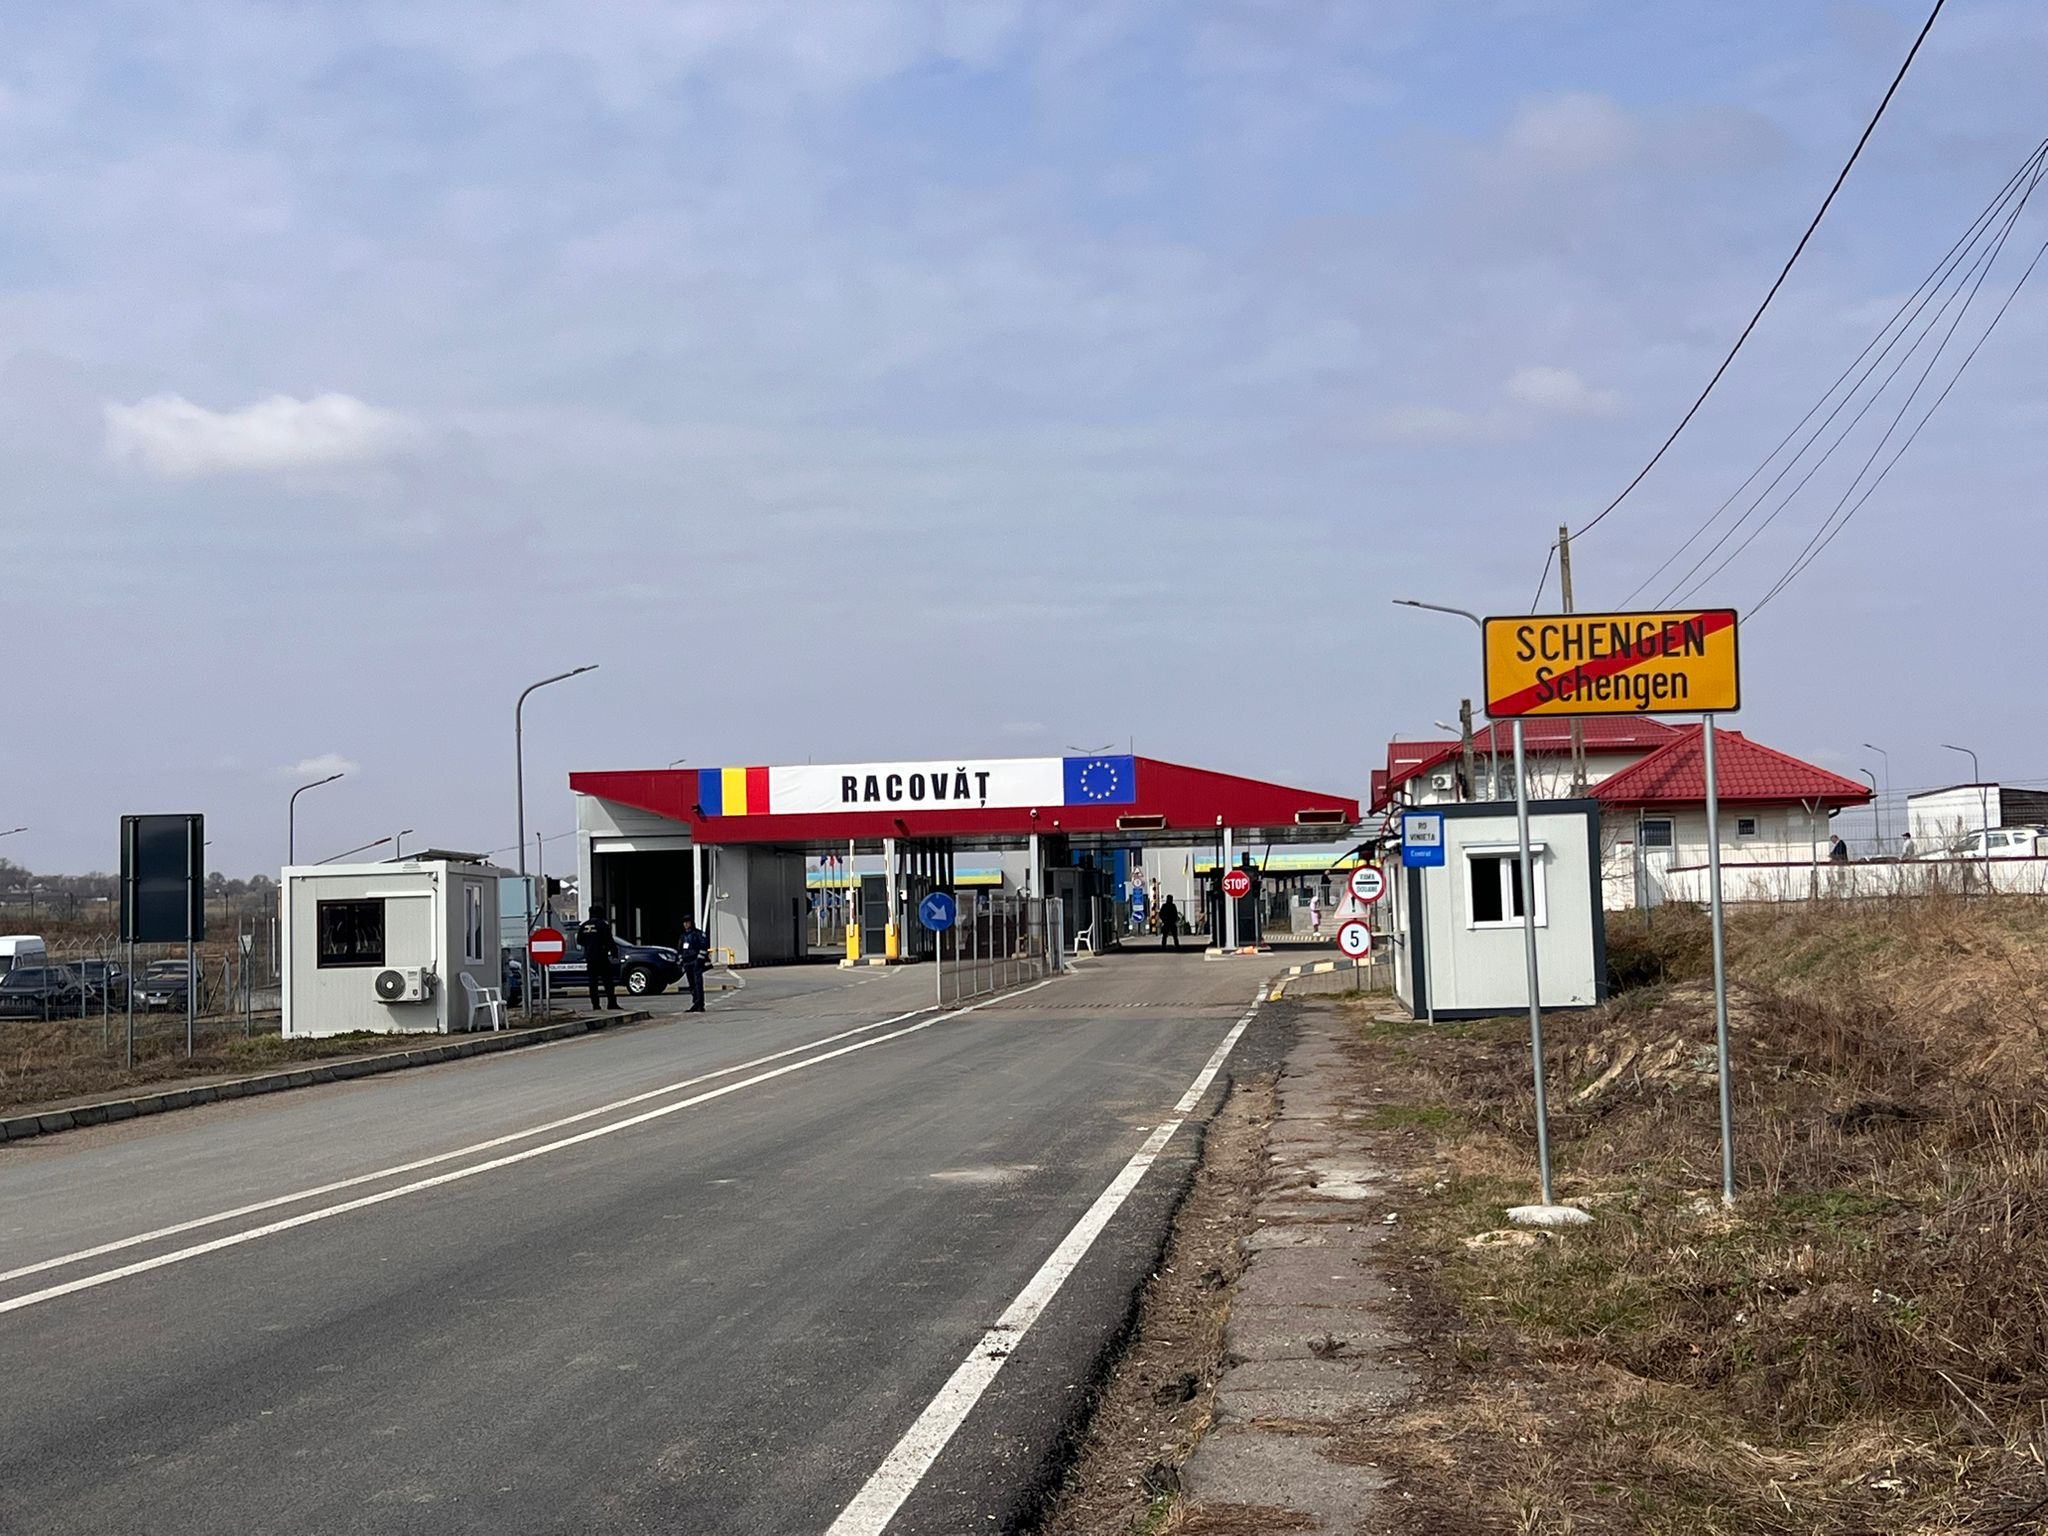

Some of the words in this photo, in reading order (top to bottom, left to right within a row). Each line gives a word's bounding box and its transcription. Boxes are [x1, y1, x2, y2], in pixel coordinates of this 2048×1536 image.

[1516, 621, 1705, 662] SCHENGEN
[1536, 666, 1688, 709] Schengen
[842, 767, 990, 807] RACOVĂȚ
[1224, 878, 1248, 890] STOP
[1350, 930, 1359, 948] 5
